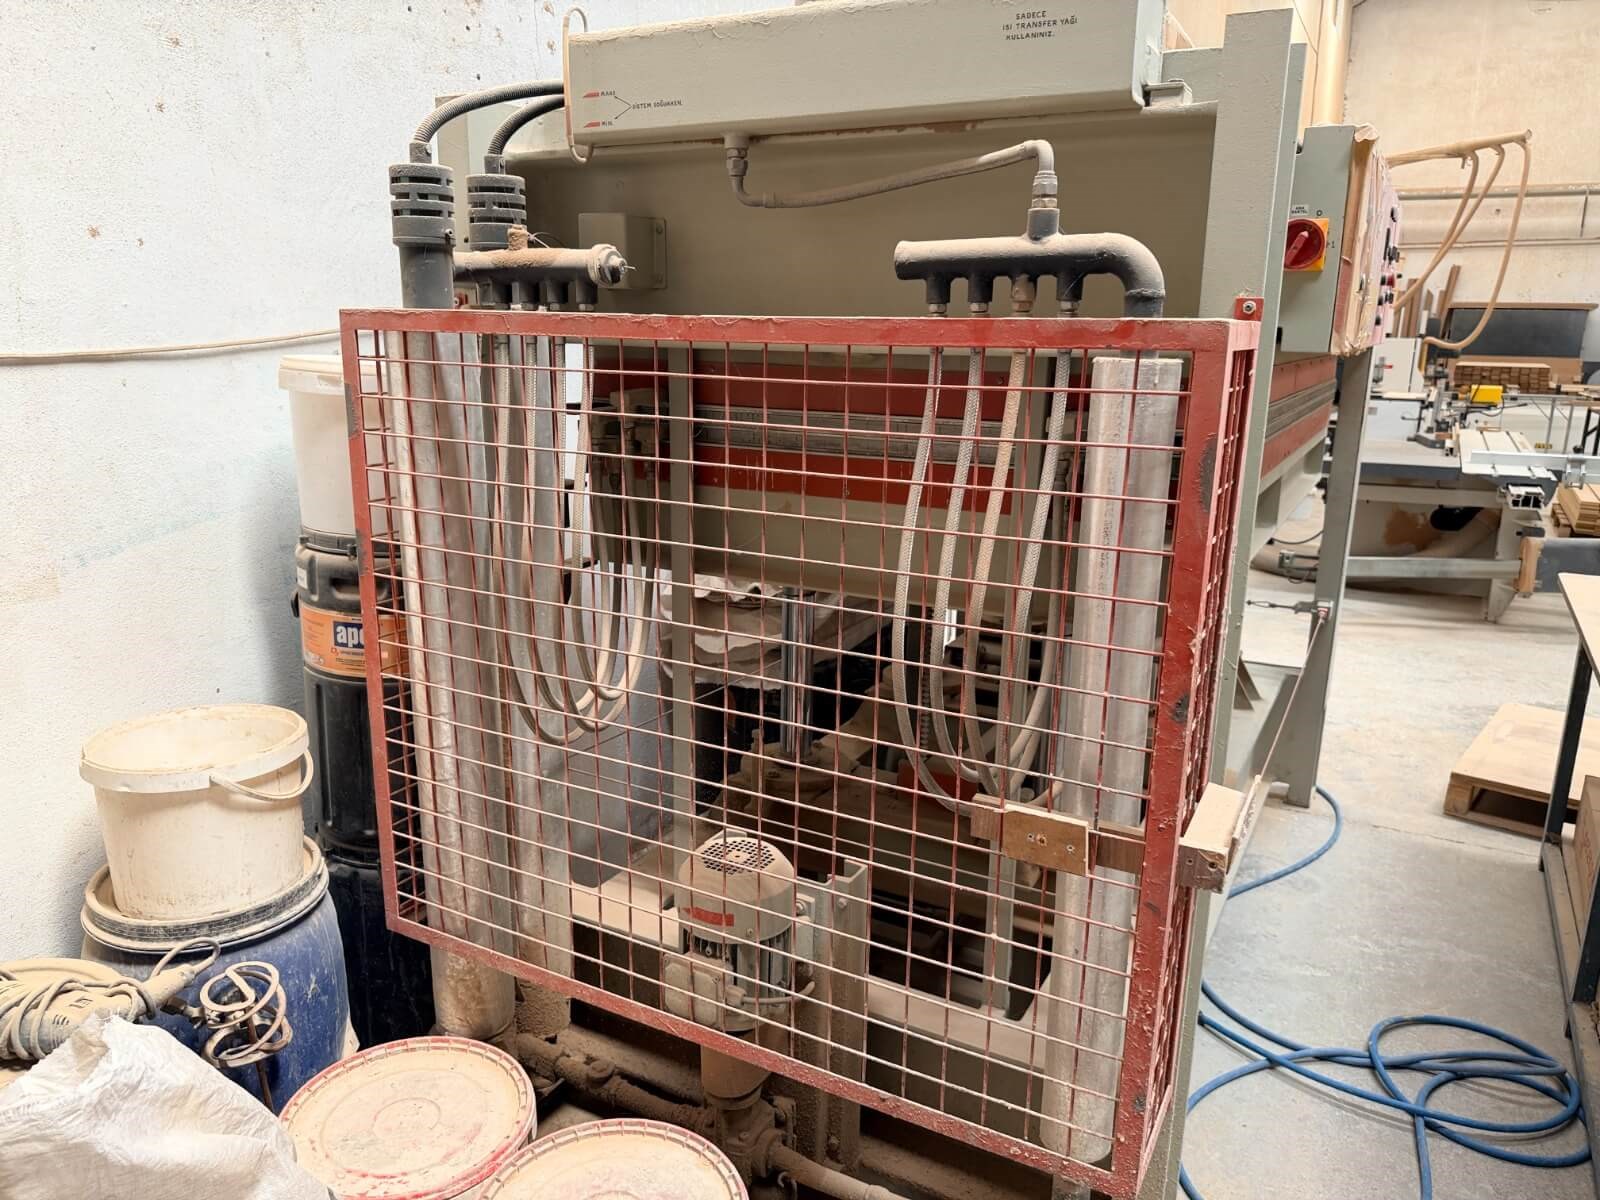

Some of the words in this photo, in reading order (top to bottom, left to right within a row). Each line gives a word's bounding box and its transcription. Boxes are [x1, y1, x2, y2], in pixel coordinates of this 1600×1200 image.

[1016, 10, 1047, 20] SADECE
[1016, 19, 1058, 29] TRANSFER
[1060, 14, 1078, 25] YAĞI
